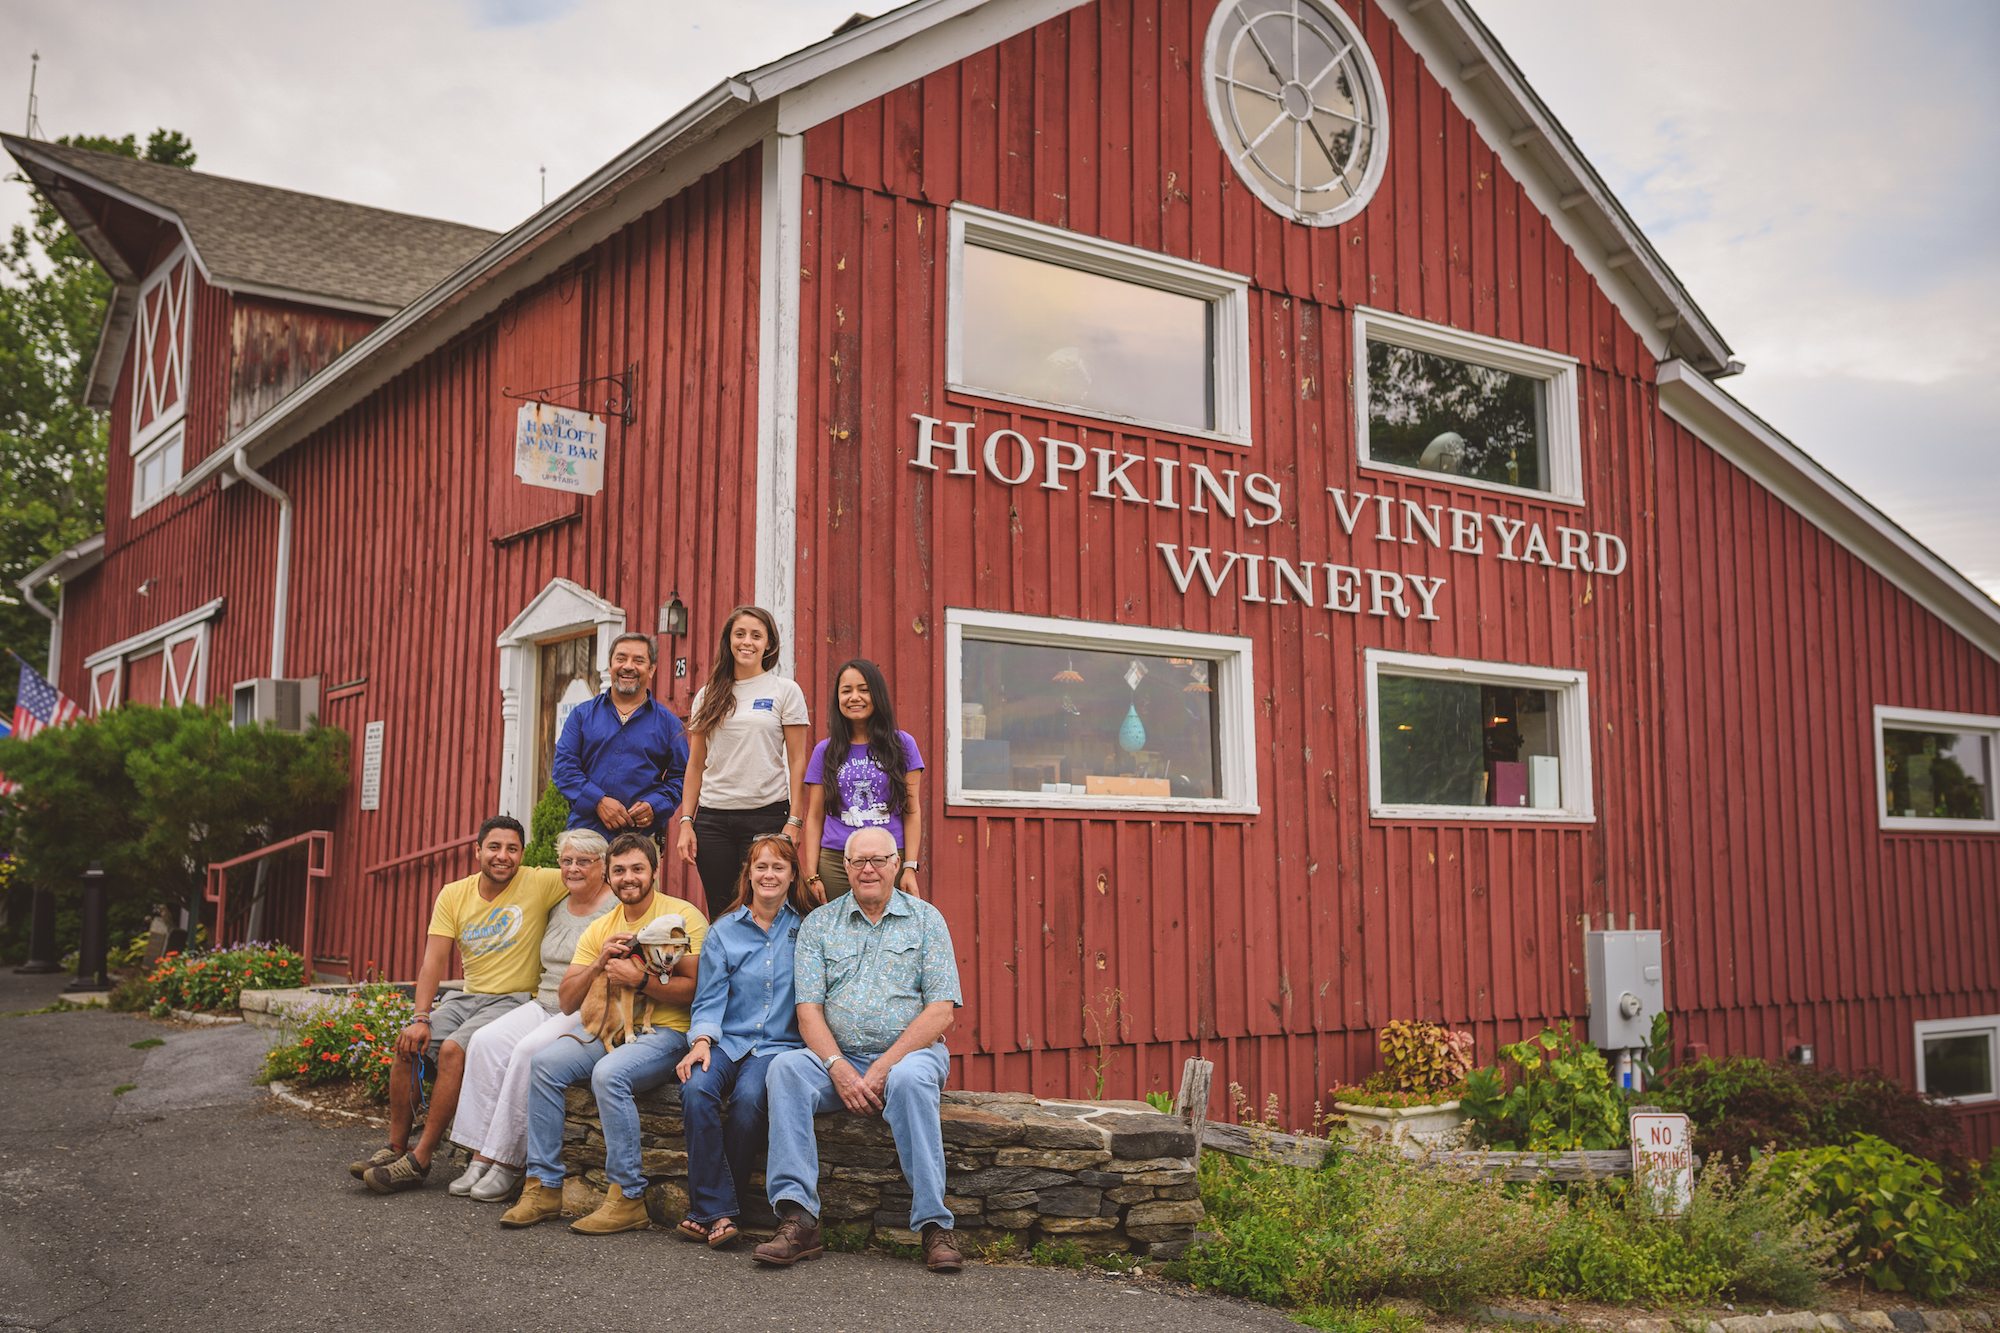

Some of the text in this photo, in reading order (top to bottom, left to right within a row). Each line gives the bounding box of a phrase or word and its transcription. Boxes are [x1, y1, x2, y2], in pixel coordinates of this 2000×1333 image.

[554, 412, 573, 426] The
[525, 436, 598, 461] WINE BAR
[908, 413, 1627, 576] HOPKINS VINEYARD
[1156, 542, 1447, 621] WINERY
[675, 659, 686, 677] 25
[1651, 1127, 1672, 1145] NO
